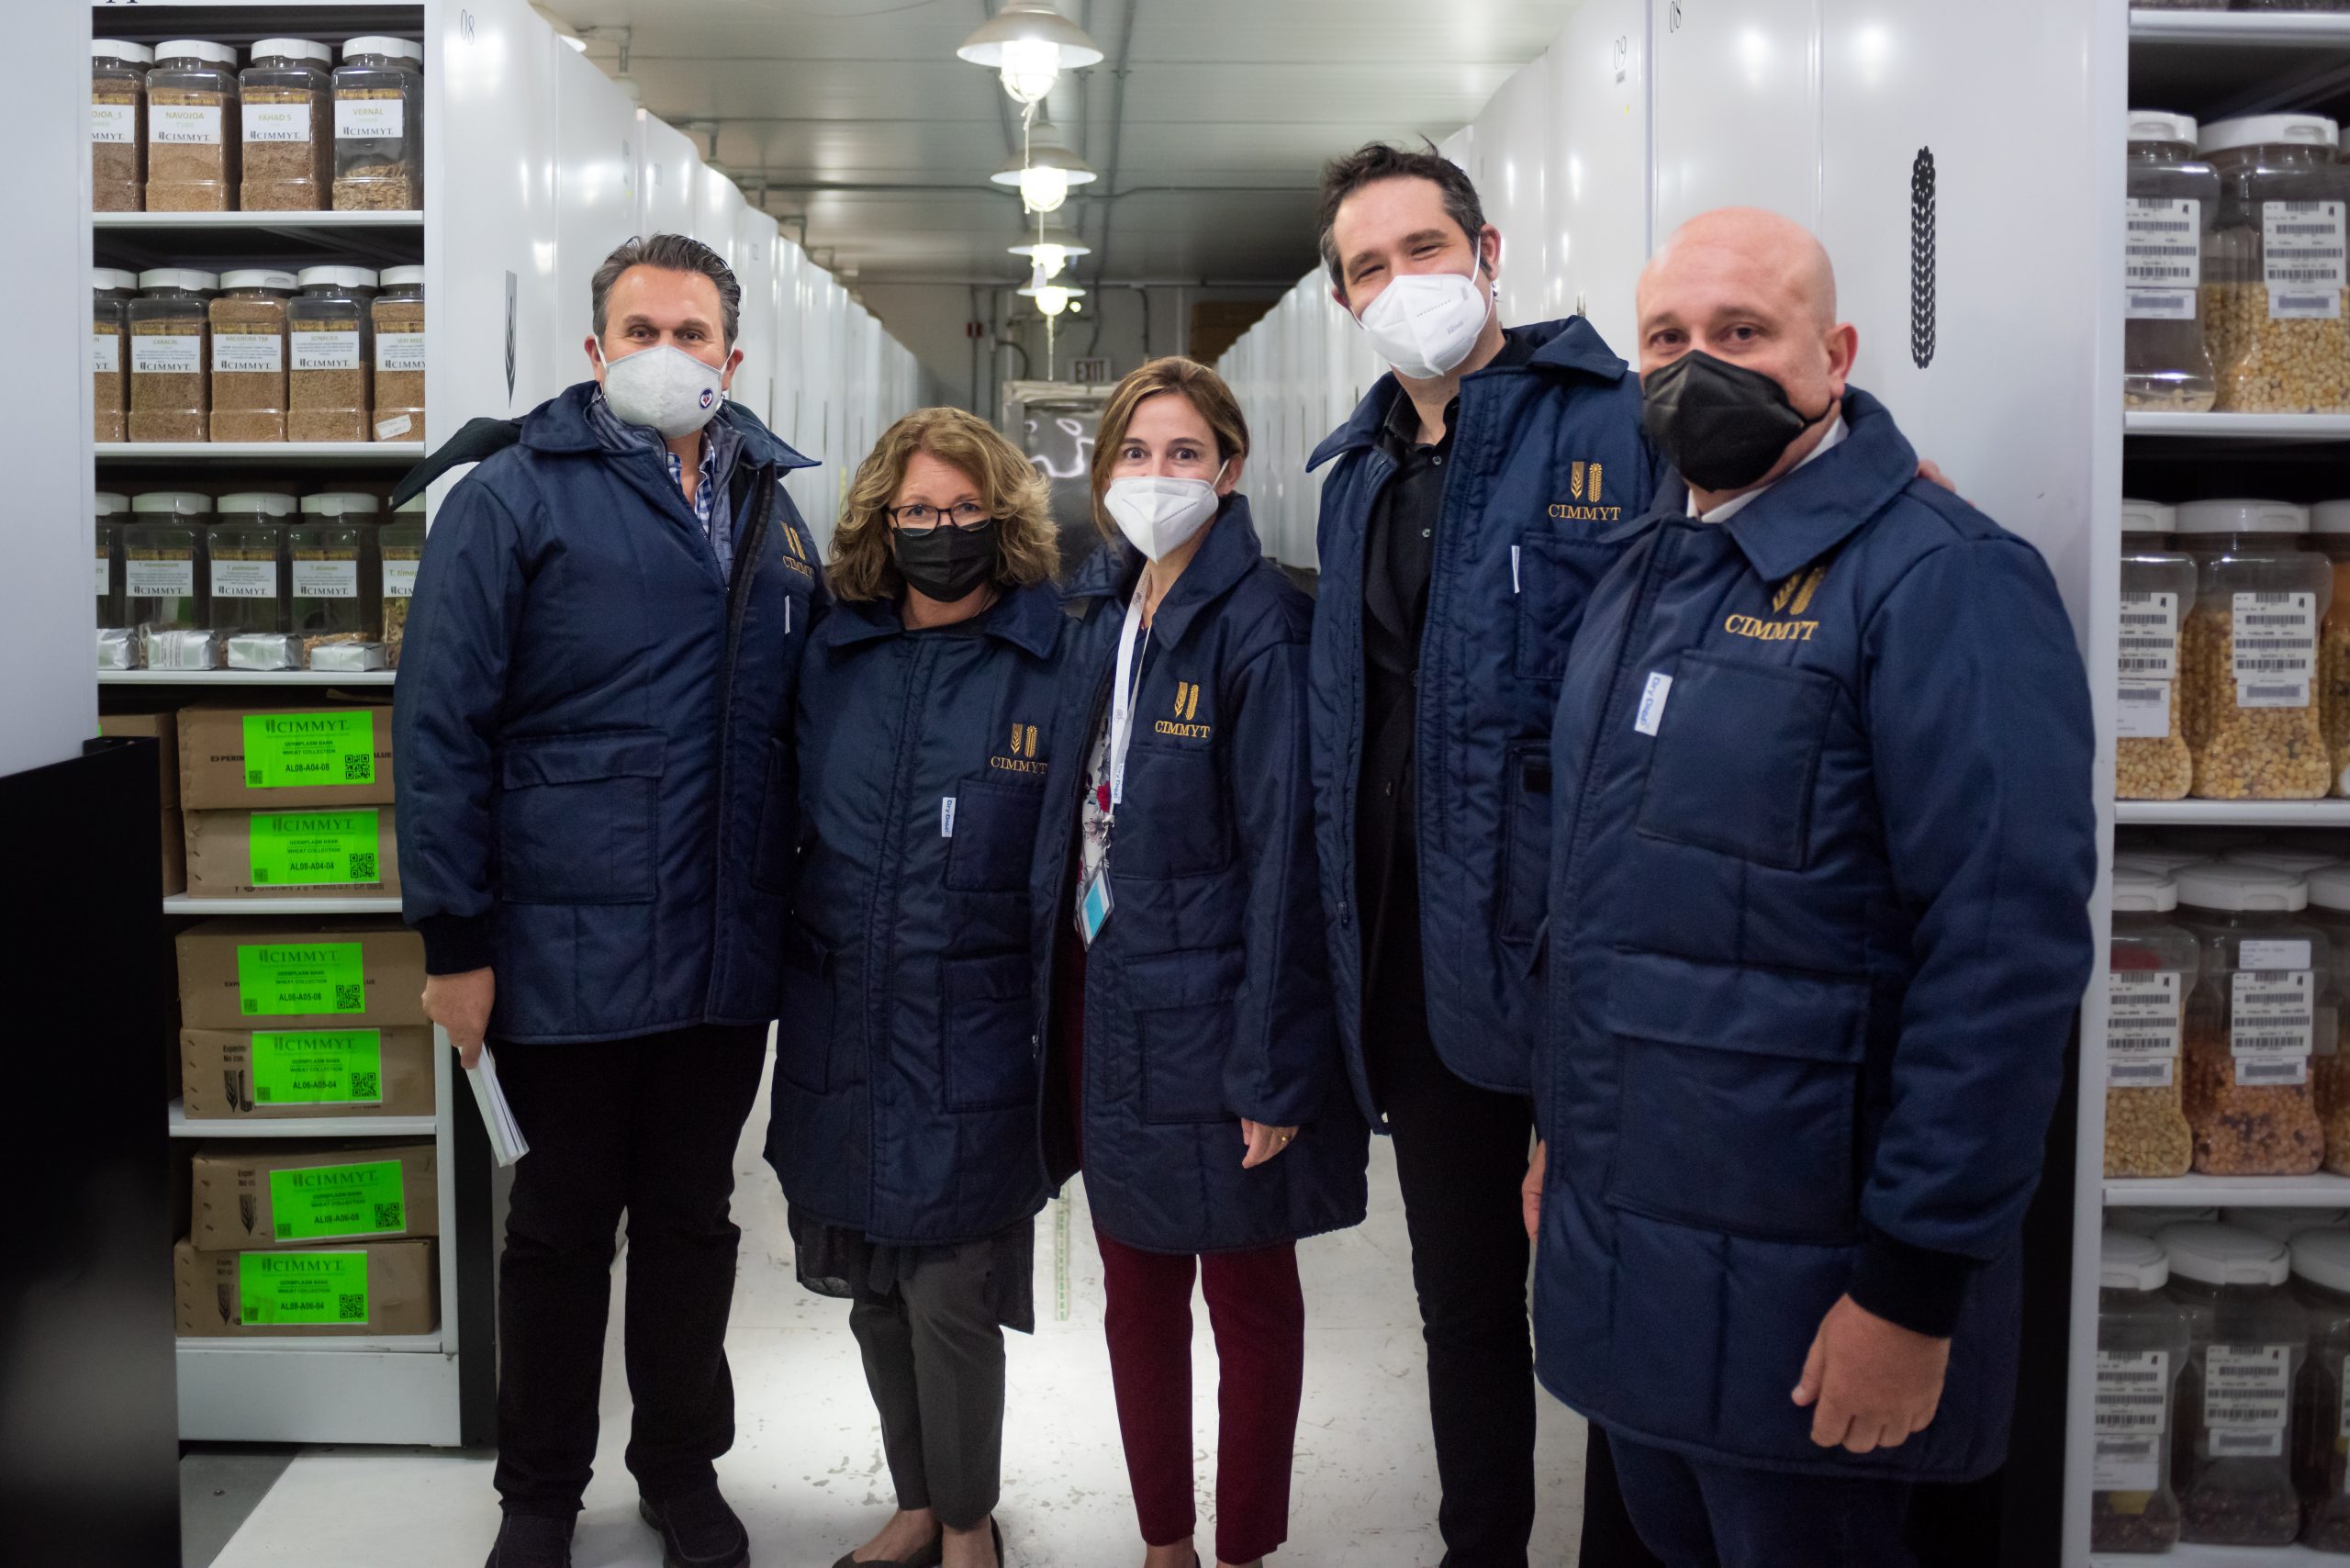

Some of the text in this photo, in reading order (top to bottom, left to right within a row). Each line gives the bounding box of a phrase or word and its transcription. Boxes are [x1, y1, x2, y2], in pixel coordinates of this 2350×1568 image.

[460, 9, 475, 45] 08
[165, 111, 205, 119] NAVOJOA
[258, 113, 285, 121] FAHAD
[165, 133, 208, 141] CIMMYT
[256, 131, 299, 140] CIMMYT
[350, 127, 393, 135] CIMMYT
[147, 363, 189, 371] CIMMYT
[228, 361, 271, 370] CIMMYT
[307, 359, 349, 367] CIMMYT
[1075, 360, 1105, 383] EXIT
[1549, 504, 1621, 521] CIMMYT
[140, 587, 183, 595] CIMMYT
[1725, 613, 1819, 641] CIMMYT
[277, 719, 347, 734] CIMMYT
[1154, 720, 1211, 739] CIMMYT
[285, 763, 330, 773] AL08-A04-08
[990, 756, 1047, 774] CIMMYT
[283, 818, 353, 833] CIMMYT
[290, 861, 334, 871] AL08-A04-04
[270, 949, 339, 964] CIMMYT
[285, 1036, 354, 1052] CIMMYT
[305, 1170, 377, 1188] CIMMYT
[273, 1259, 343, 1272] CIMMYT
